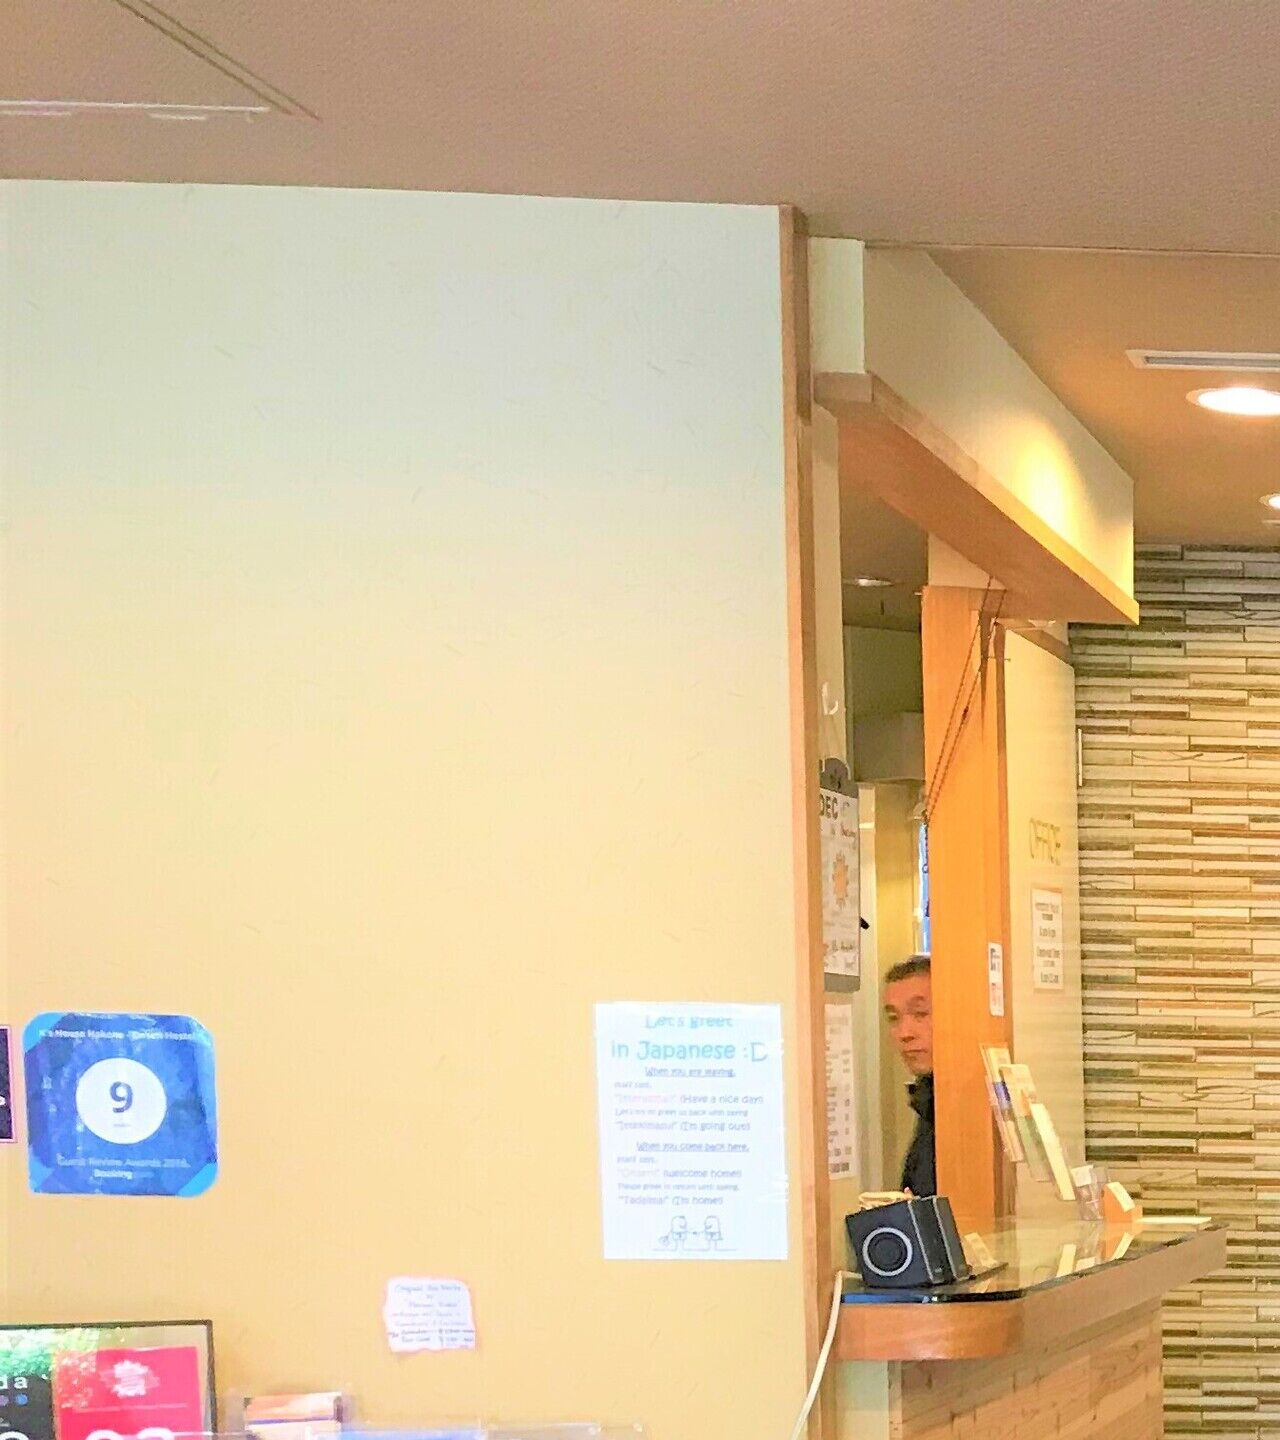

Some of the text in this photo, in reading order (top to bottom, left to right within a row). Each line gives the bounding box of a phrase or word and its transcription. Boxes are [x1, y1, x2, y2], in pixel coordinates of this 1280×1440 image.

[611, 1040, 629, 1058] in
[636, 1040, 736, 1061] Japanese
[110, 1081, 133, 1113] 9
